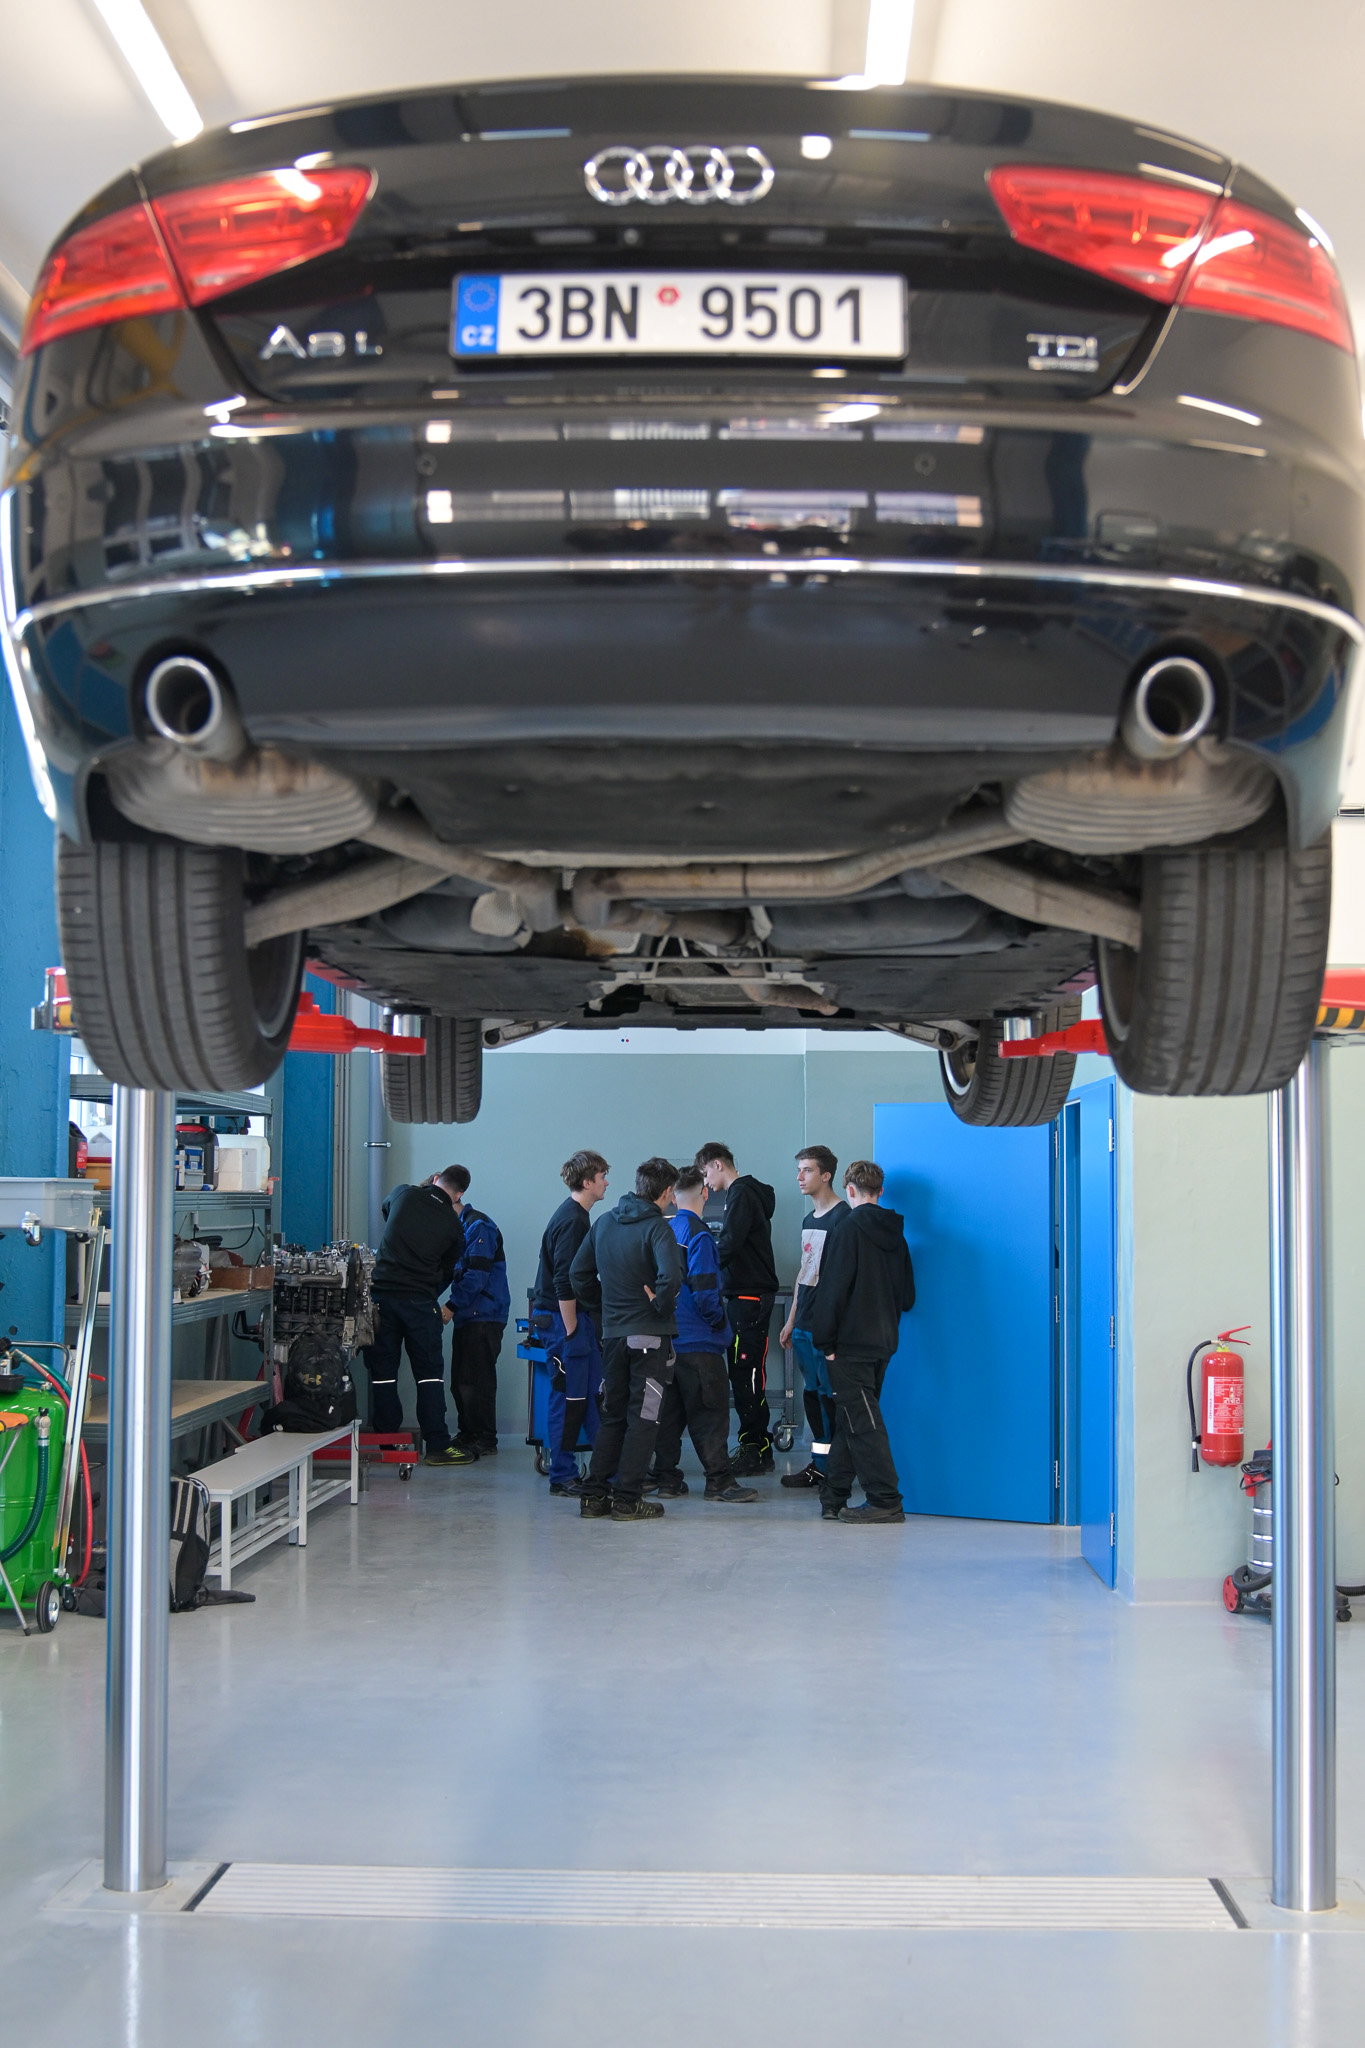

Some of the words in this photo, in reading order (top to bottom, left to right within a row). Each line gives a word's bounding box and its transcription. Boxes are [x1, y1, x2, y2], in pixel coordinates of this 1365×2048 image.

[517, 285, 638, 342] 3BN
[701, 285, 861, 343] 9501
[461, 325, 495, 347] CZ
[1027, 333, 1098, 358] TDI
